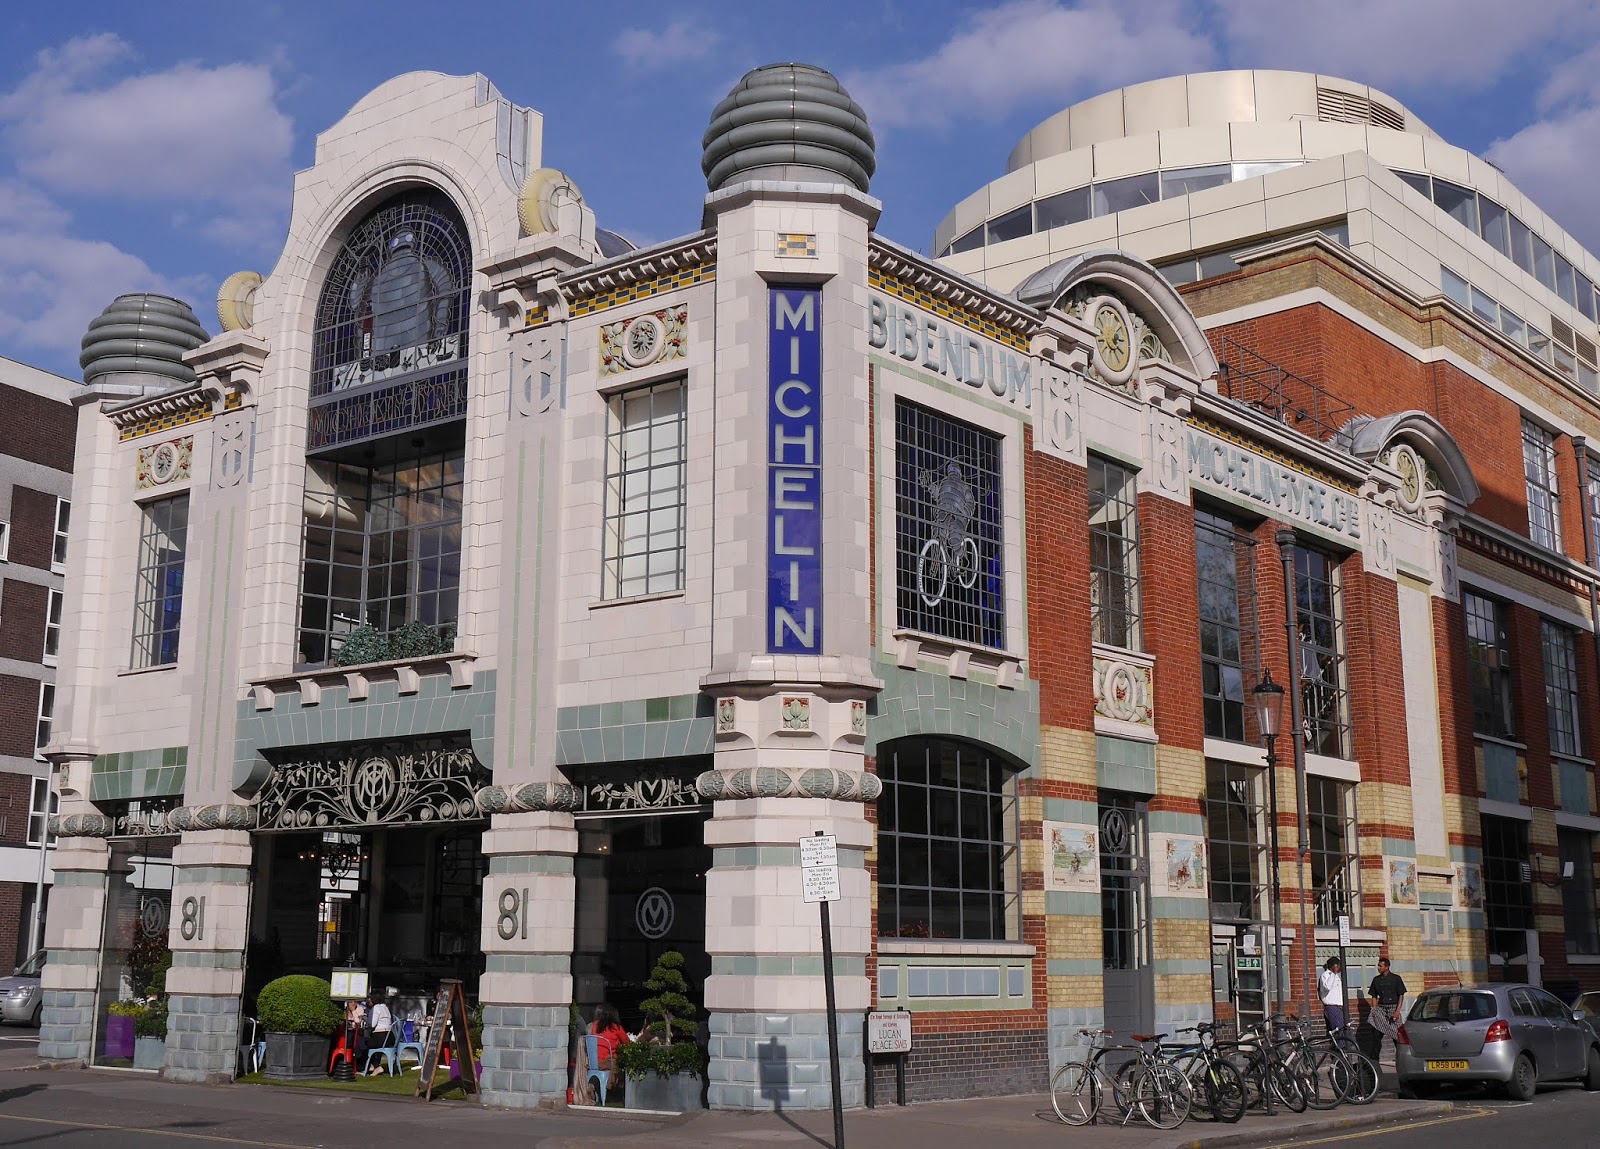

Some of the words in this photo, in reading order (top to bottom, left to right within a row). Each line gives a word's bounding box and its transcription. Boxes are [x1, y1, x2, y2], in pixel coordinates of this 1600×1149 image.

[868, 294, 1032, 409] BIBENDUM
[774, 291, 815, 648] MICHELIN
[181, 896, 205, 940] 81
[497, 888, 529, 940] 81
[872, 1040, 893, 1049] PLACE
[879, 1030, 902, 1039] LUCAN
